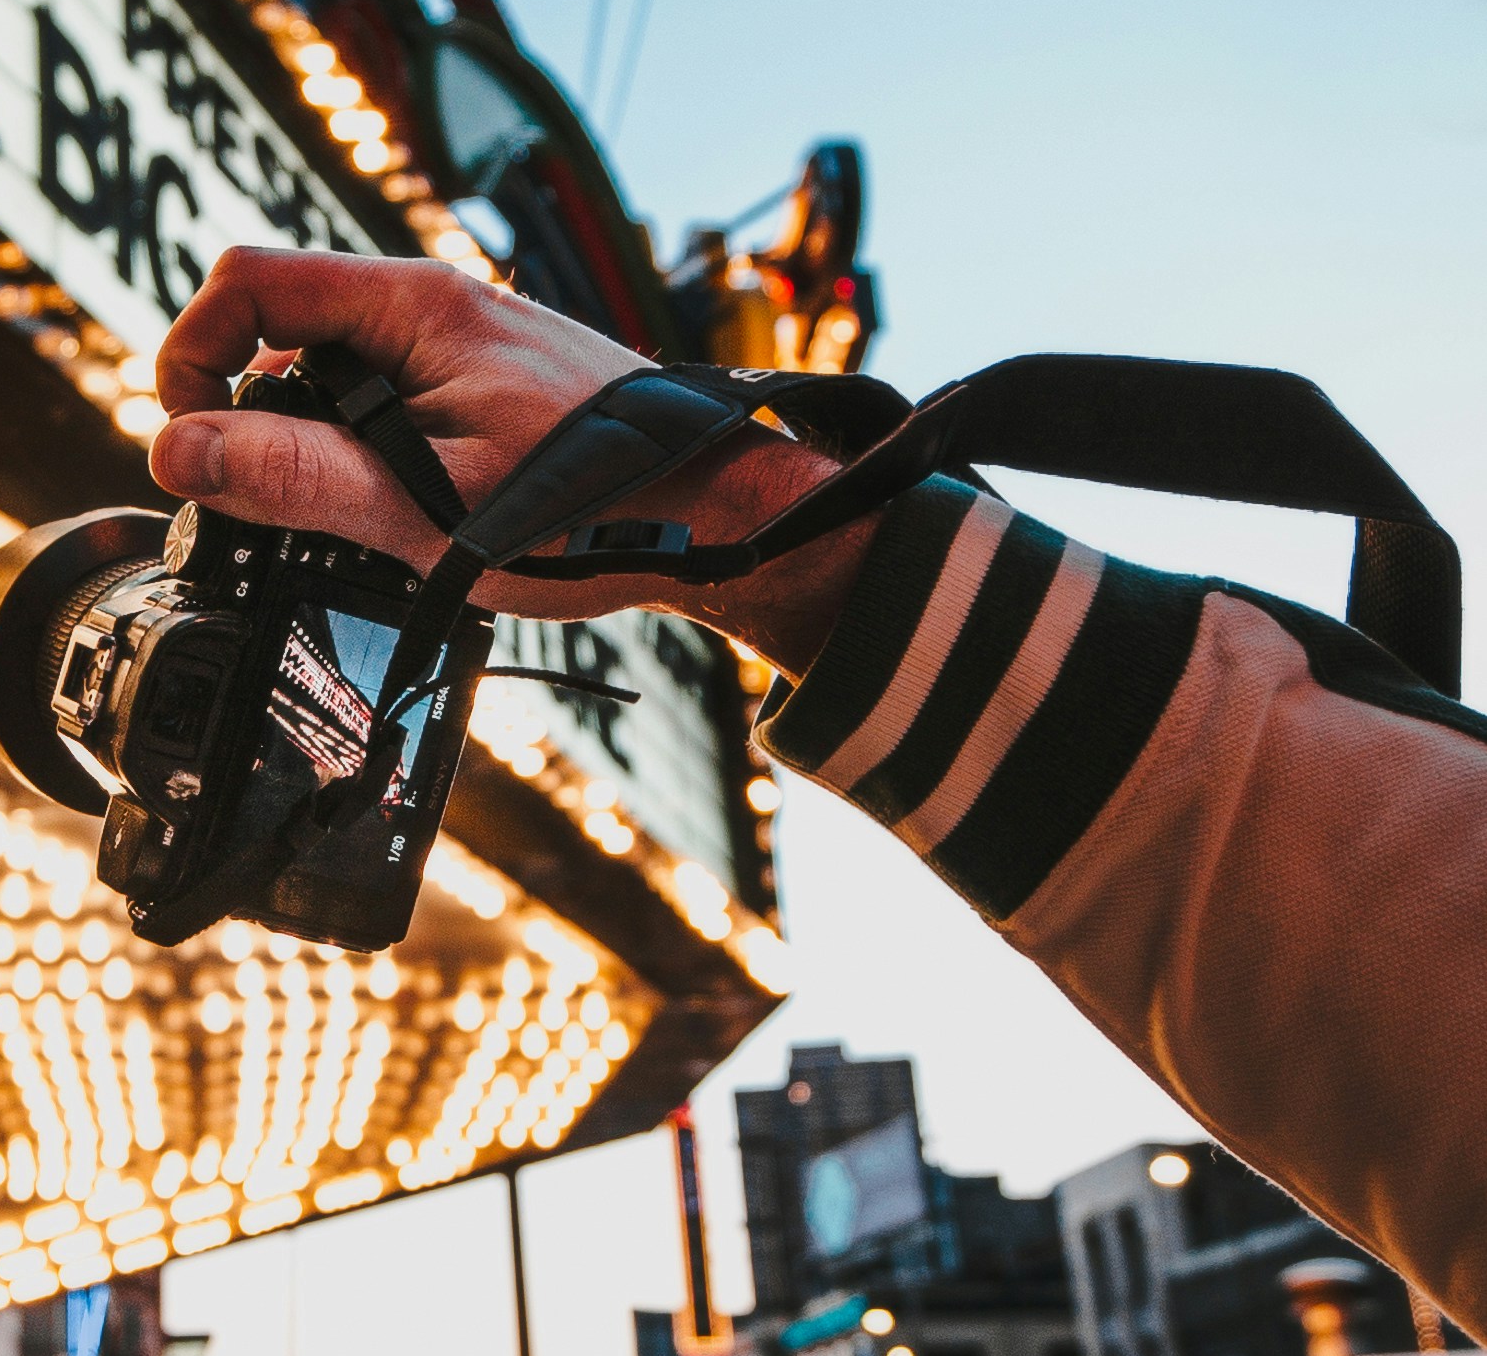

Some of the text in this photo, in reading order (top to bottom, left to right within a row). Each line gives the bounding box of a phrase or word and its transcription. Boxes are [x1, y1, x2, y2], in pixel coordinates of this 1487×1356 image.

[35, 5, 207, 321] BIG
[325, 550, 337, 569] AEL
[235, 580, 249, 597] C2
[428, 760, 449, 811] SONY
[387, 834, 406, 863] 1/80
